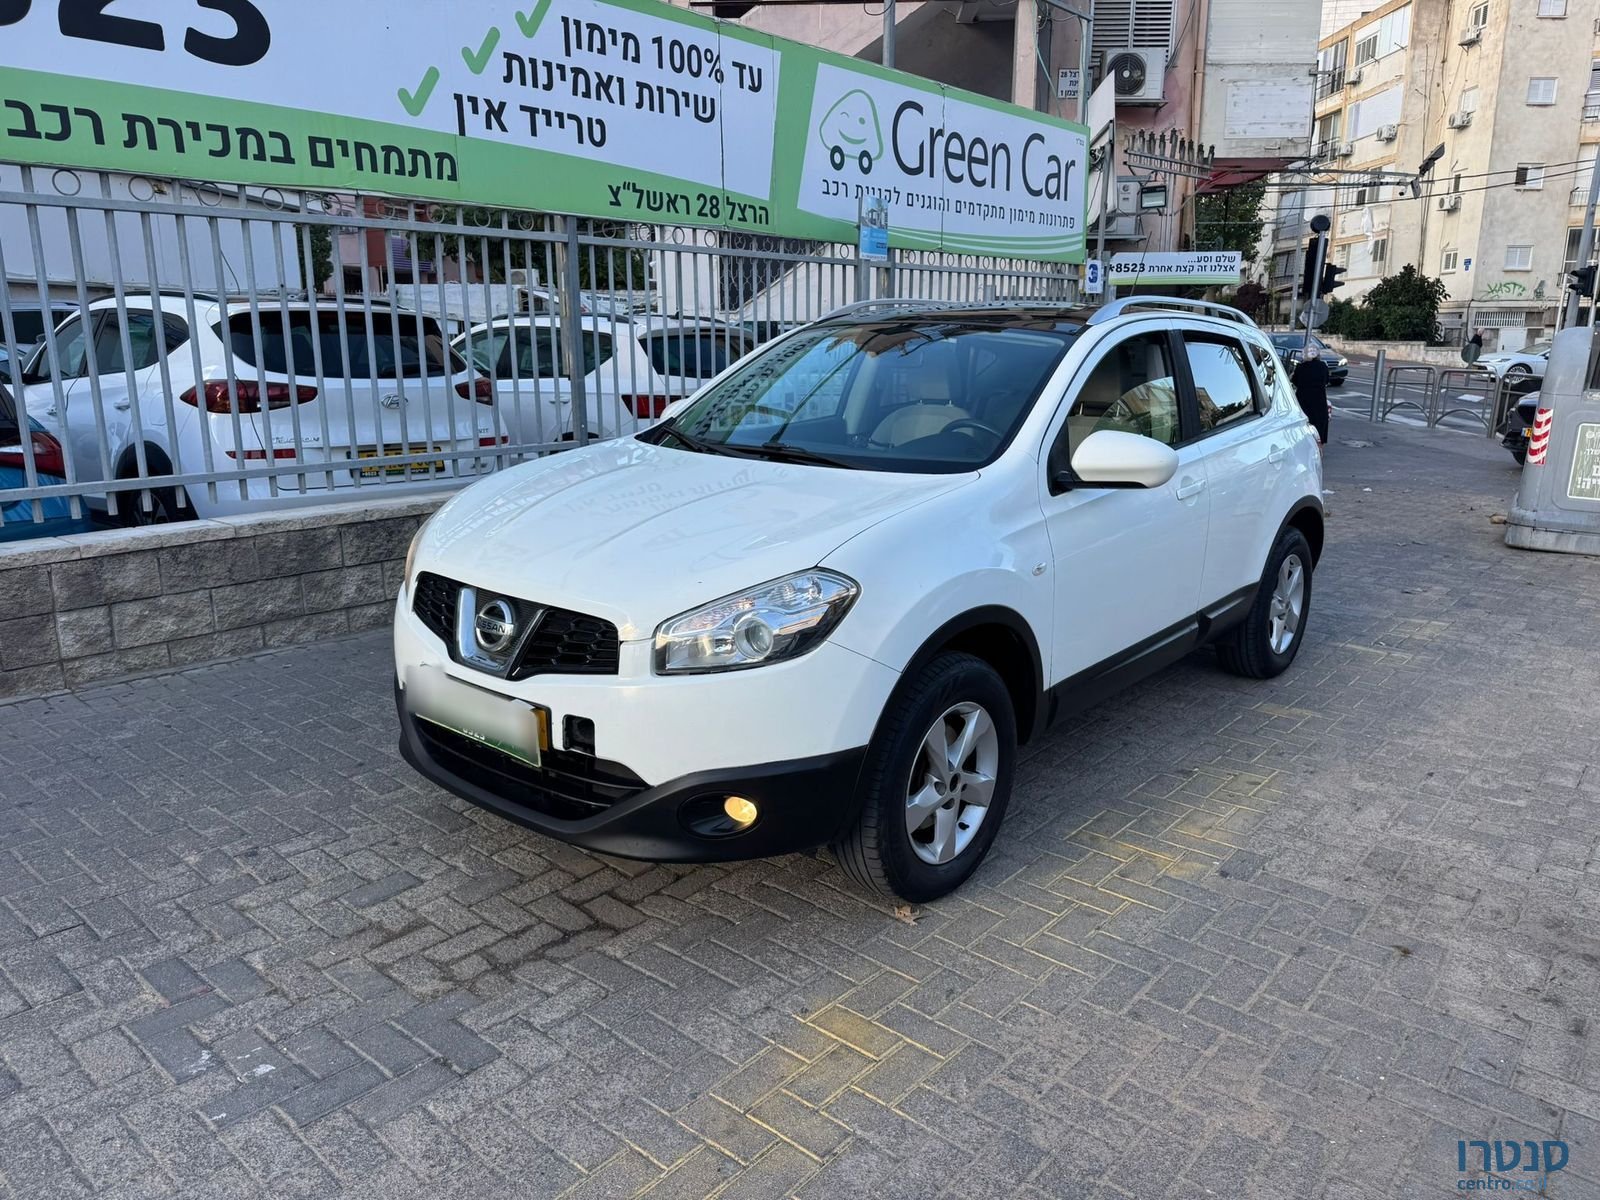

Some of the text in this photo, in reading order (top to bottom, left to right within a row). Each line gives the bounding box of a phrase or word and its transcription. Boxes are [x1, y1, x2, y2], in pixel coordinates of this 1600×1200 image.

[561, 16, 762, 93] עד 100% מימון
[503, 51, 715, 123] שירות ואמינות
[454, 93, 606, 147] טרייד אין
[4, 99, 458, 182] מתמחים במכירת רכב
[891, 100, 1076, 201] Green Car
[822, 178, 849, 198] רכב
[608, 181, 769, 225] הרצל 28 ראשל"צ
[907, 192, 950, 212] והוגנים
[955, 199, 1004, 220] מתקדמים
[1009, 207, 1035, 225] מימון
[1038, 211, 1075, 229] פתרונות
[1148, 264, 1173, 273] אחרת
[1197, 264, 1207, 273] זה
[1210, 263, 1235, 273] אצלנו
[1215, 254, 1236, 263] שלם
[1176, 265, 1195, 275] קצת
